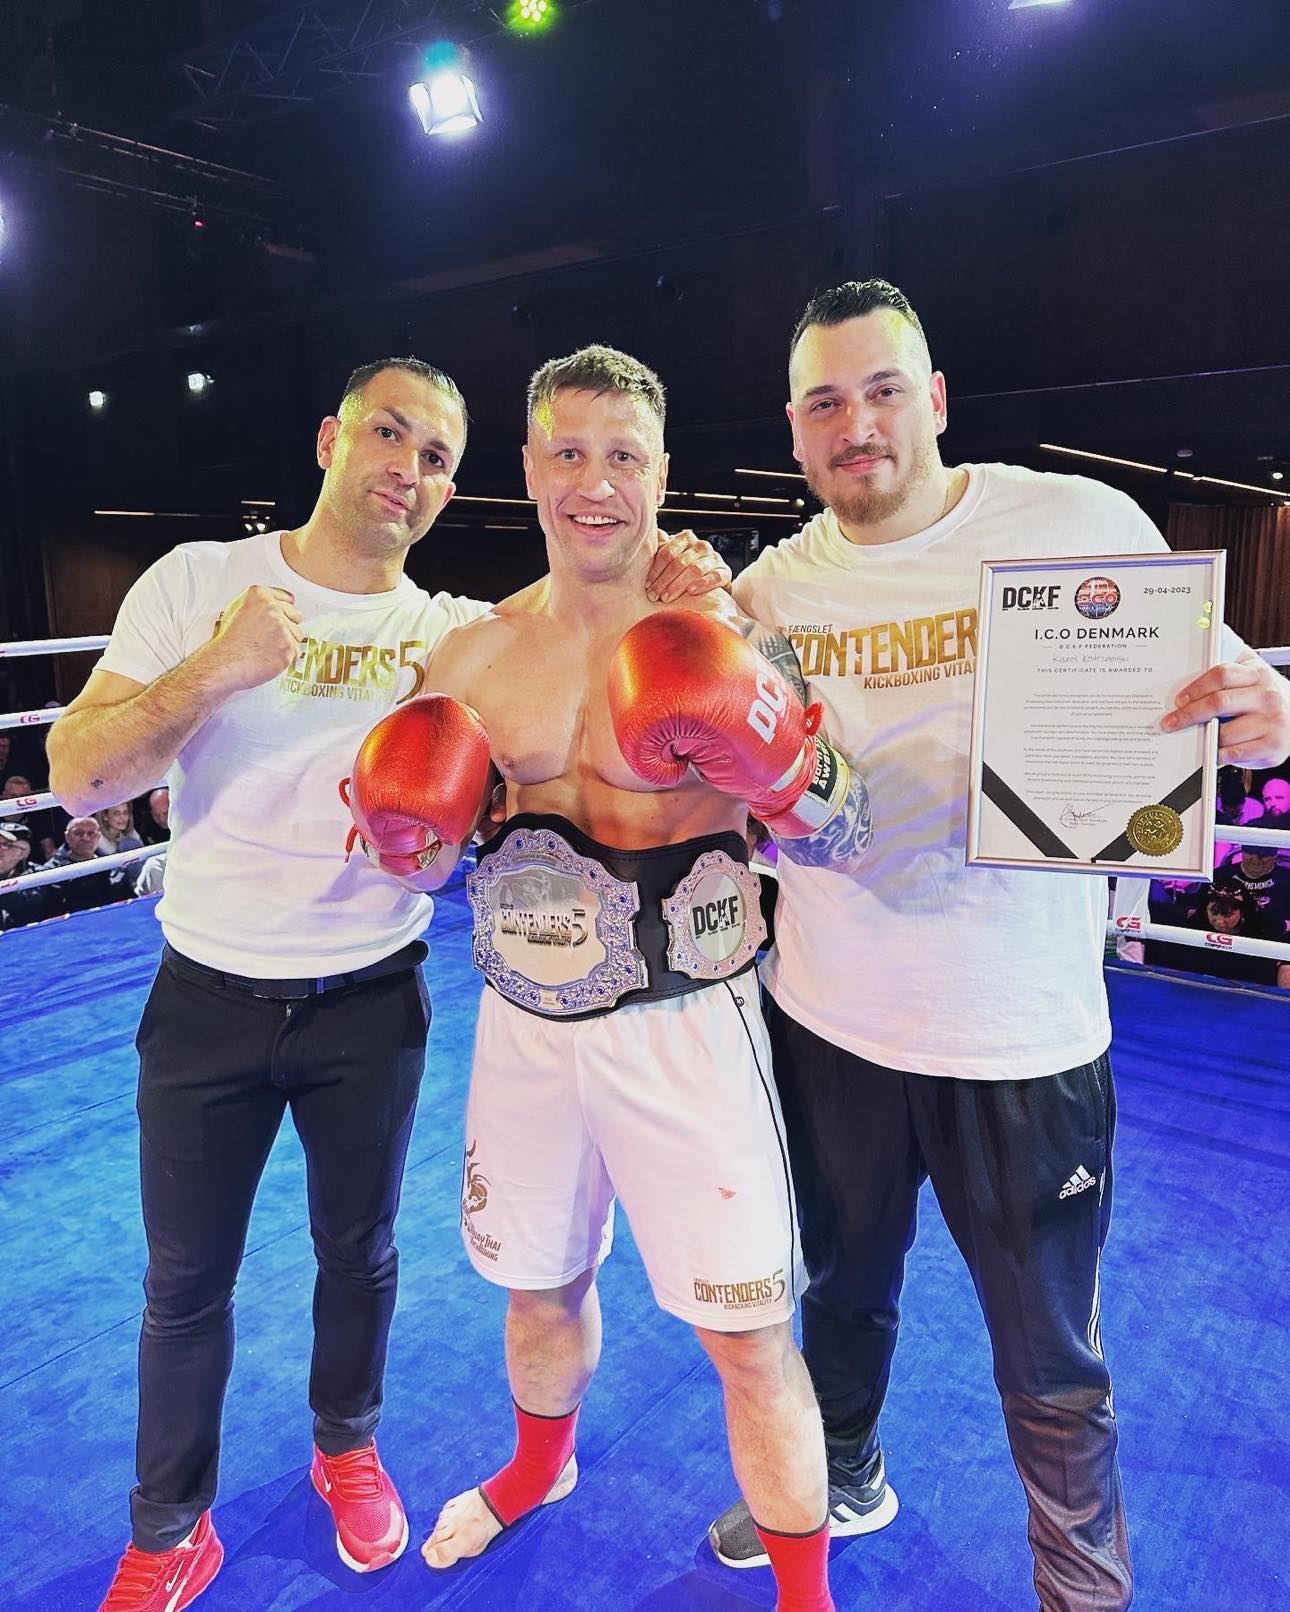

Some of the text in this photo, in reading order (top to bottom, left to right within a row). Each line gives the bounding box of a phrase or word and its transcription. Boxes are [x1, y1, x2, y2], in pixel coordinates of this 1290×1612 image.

[1002, 585, 1061, 609] DCKF
[1143, 586, 1191, 595] 29-04-2023
[788, 623, 832, 634] FÆNGSLET
[1034, 626, 1160, 640] I.C.O DENMARK
[787, 607, 979, 677] ONTENDER
[286, 637, 426, 706] ENDERS 5
[864, 666, 940, 690] KICKBOXING
[571, 908, 588, 946] 5
[692, 895, 738, 936] DCKF
[1058, 1176, 1097, 1200] adidas
[693, 1268, 786, 1304] CONTENDERS 5
